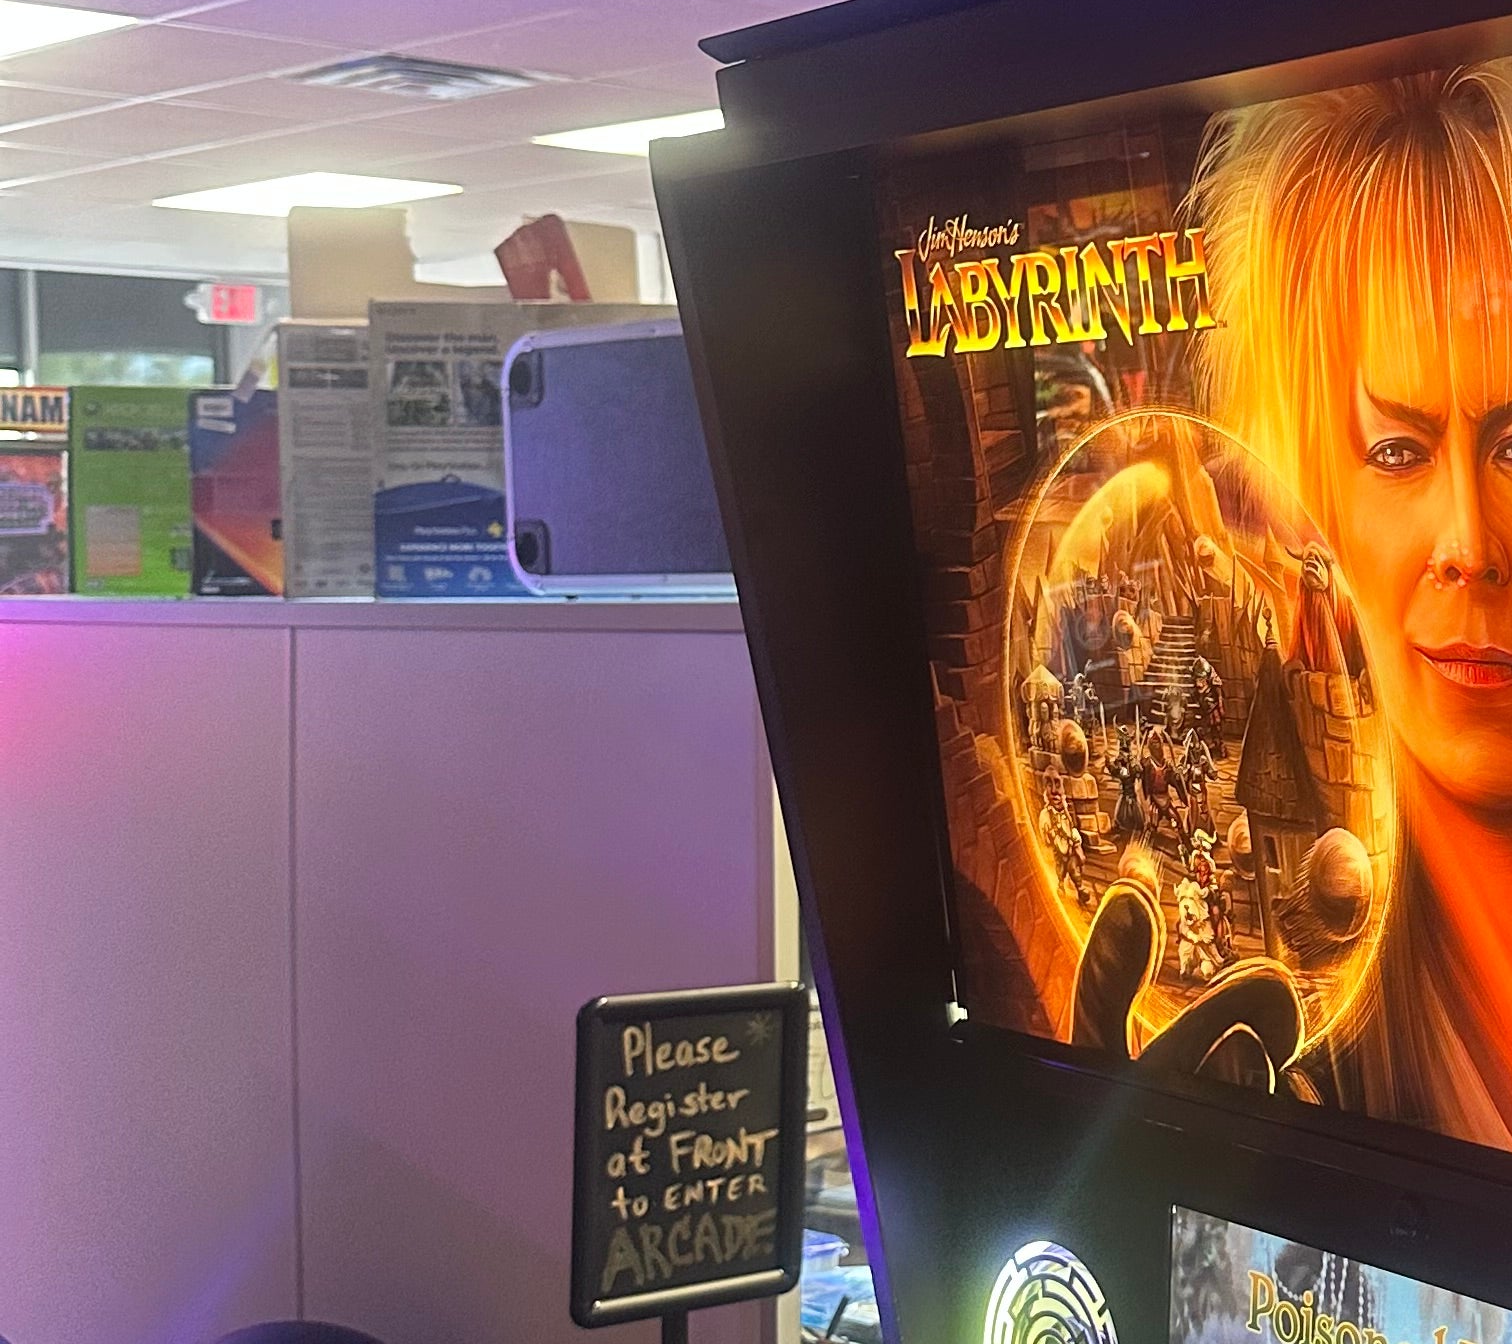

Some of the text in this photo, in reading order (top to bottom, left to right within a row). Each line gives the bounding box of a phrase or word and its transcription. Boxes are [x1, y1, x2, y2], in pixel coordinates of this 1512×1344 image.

[895, 227, 1217, 358] LABYRINTH
[621, 1022, 740, 1077] Please
[605, 1082, 749, 1138] Register
[607, 1127, 779, 1178] at FRONT
[611, 1174, 767, 1220] to ENTER
[603, 1208, 776, 1294] ARCADE
